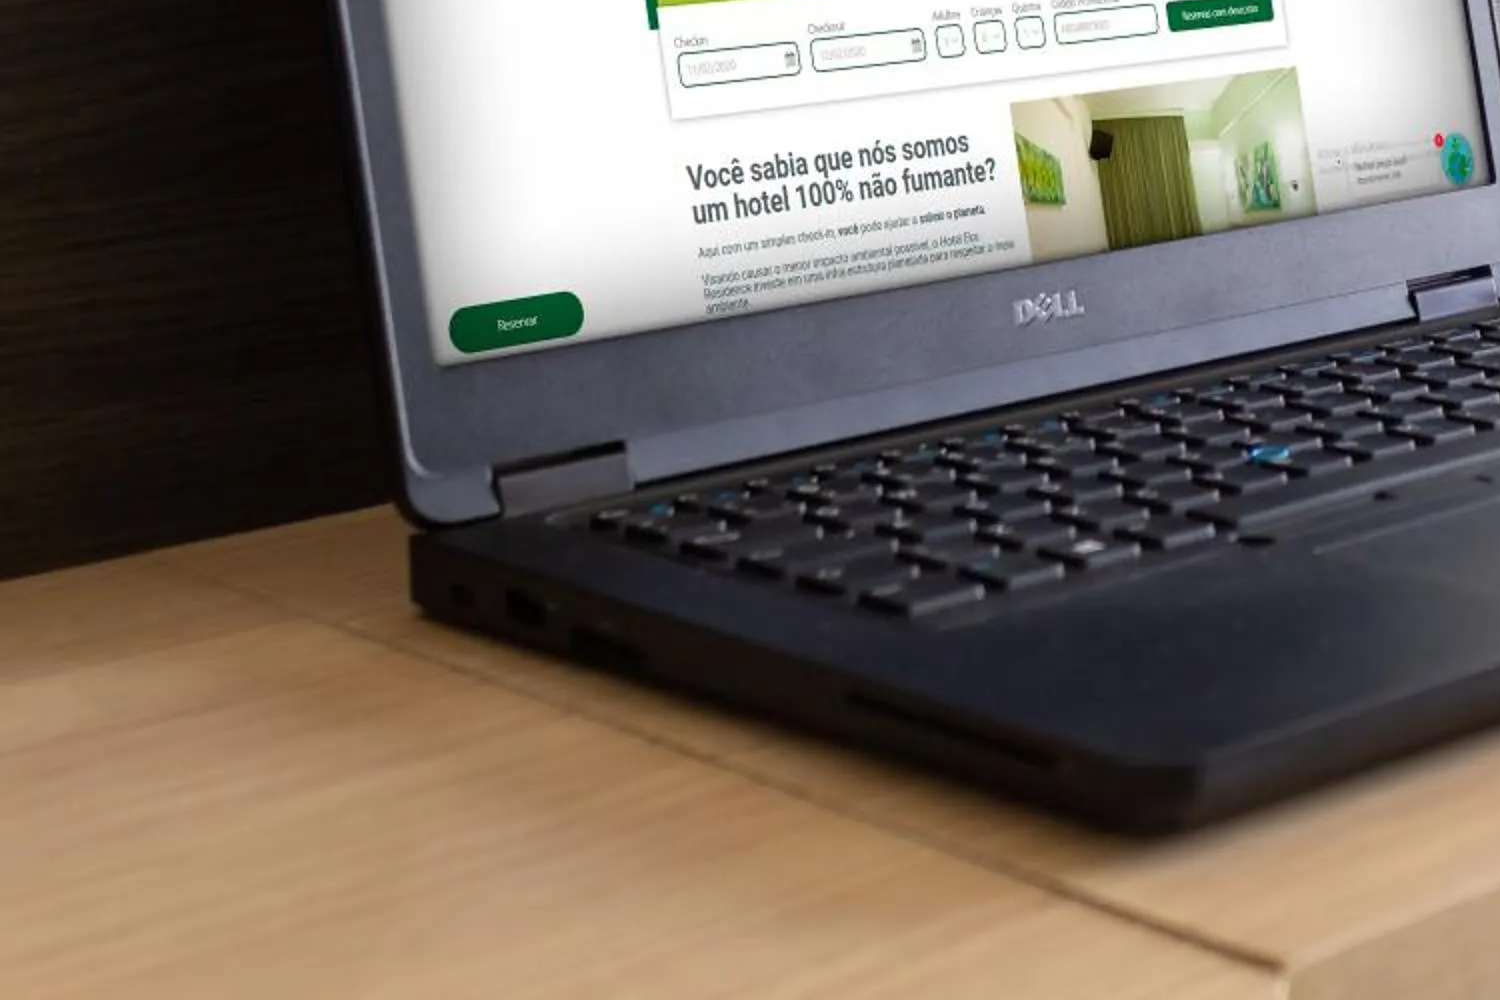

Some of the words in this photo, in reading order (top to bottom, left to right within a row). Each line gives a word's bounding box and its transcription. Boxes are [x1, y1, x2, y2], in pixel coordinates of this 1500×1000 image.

[687, 158, 745, 190] Você
[750, 153, 809, 183] sabia
[814, 149, 853, 179] que
[858, 139, 897, 168] nós
[902, 134, 970, 161] somos
[692, 201, 729, 225] um
[734, 184, 791, 219] hotel
[795, 178, 854, 210] 100%
[859, 171, 898, 201] não
[902, 156, 997, 195] fumante?
[1013, 289, 1085, 323] DELL
